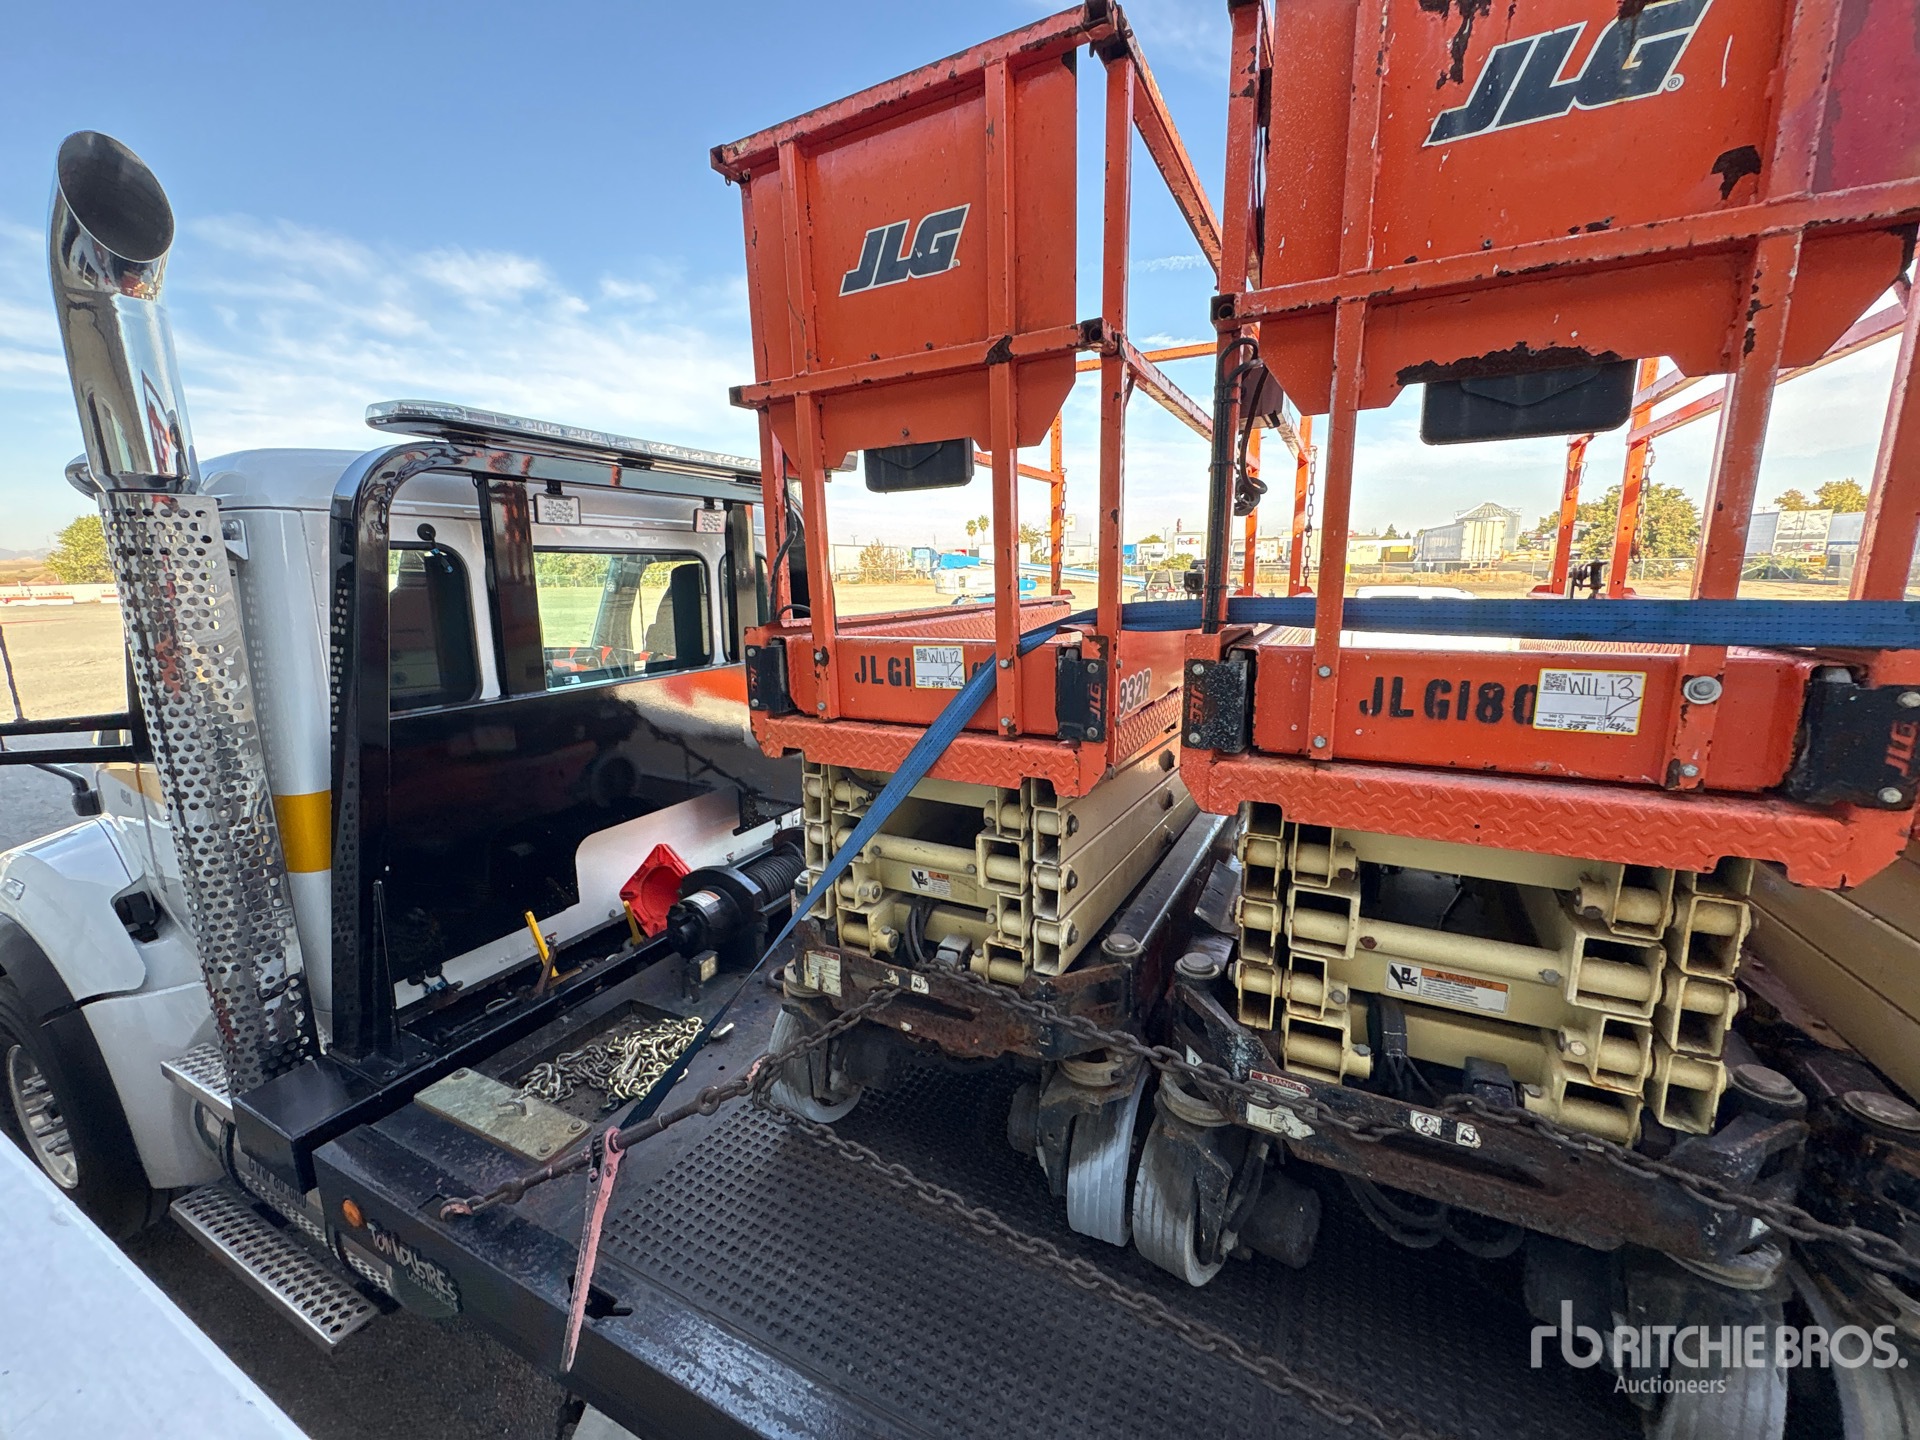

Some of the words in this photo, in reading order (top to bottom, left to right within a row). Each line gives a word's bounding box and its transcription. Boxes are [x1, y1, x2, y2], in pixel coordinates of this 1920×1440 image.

[1422, 0, 1715, 147] JLG
[839, 203, 971, 297] JLG
[1177, 538, 1200, 546] FedEx
[855, 656, 911, 687] JLG1
[1119, 667, 1152, 717] 932R
[1088, 683, 1101, 722] JLG
[1189, 683, 1204, 726] JLG
[1885, 719, 1919, 777] JLG
[1442, 972, 1492, 988] WARNING
[1272, 1078, 1307, 1093] DANGER
